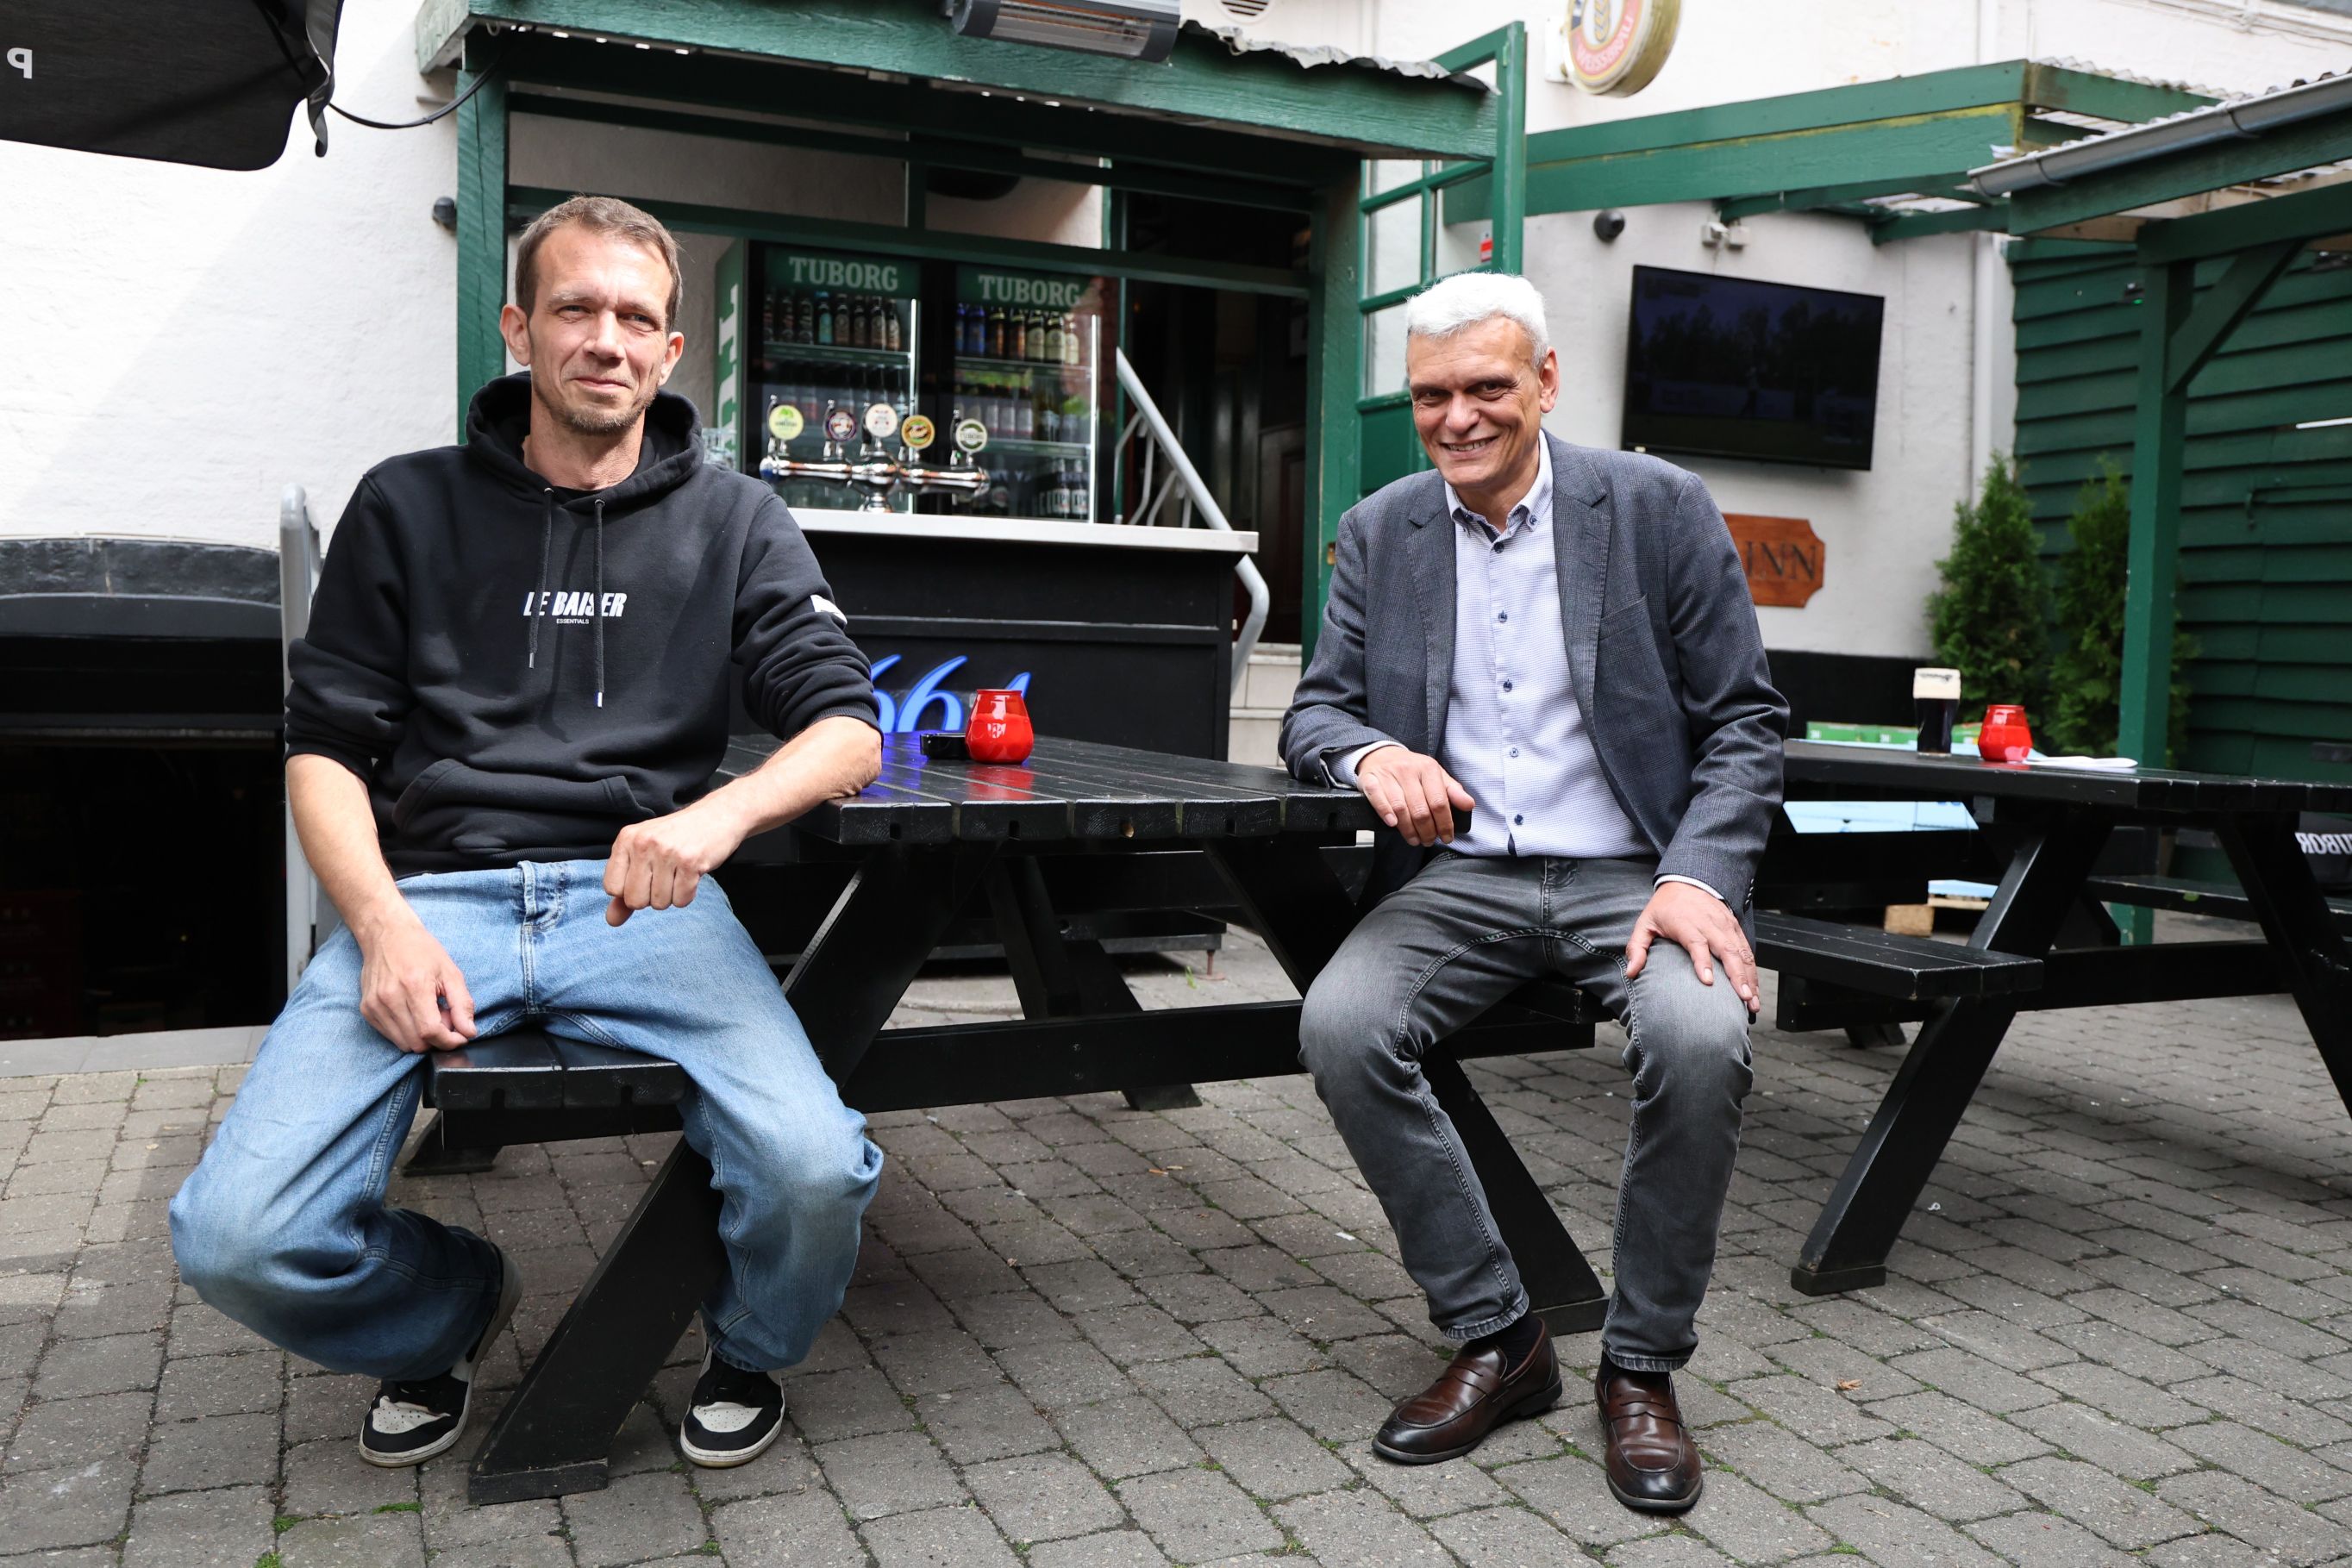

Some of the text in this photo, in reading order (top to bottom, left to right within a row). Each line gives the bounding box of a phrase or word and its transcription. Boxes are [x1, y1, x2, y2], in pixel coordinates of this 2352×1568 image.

[789, 256, 898, 292] TUBORG
[979, 275, 1079, 306] TUBORG
[522, 591, 628, 617] LE BAISER
